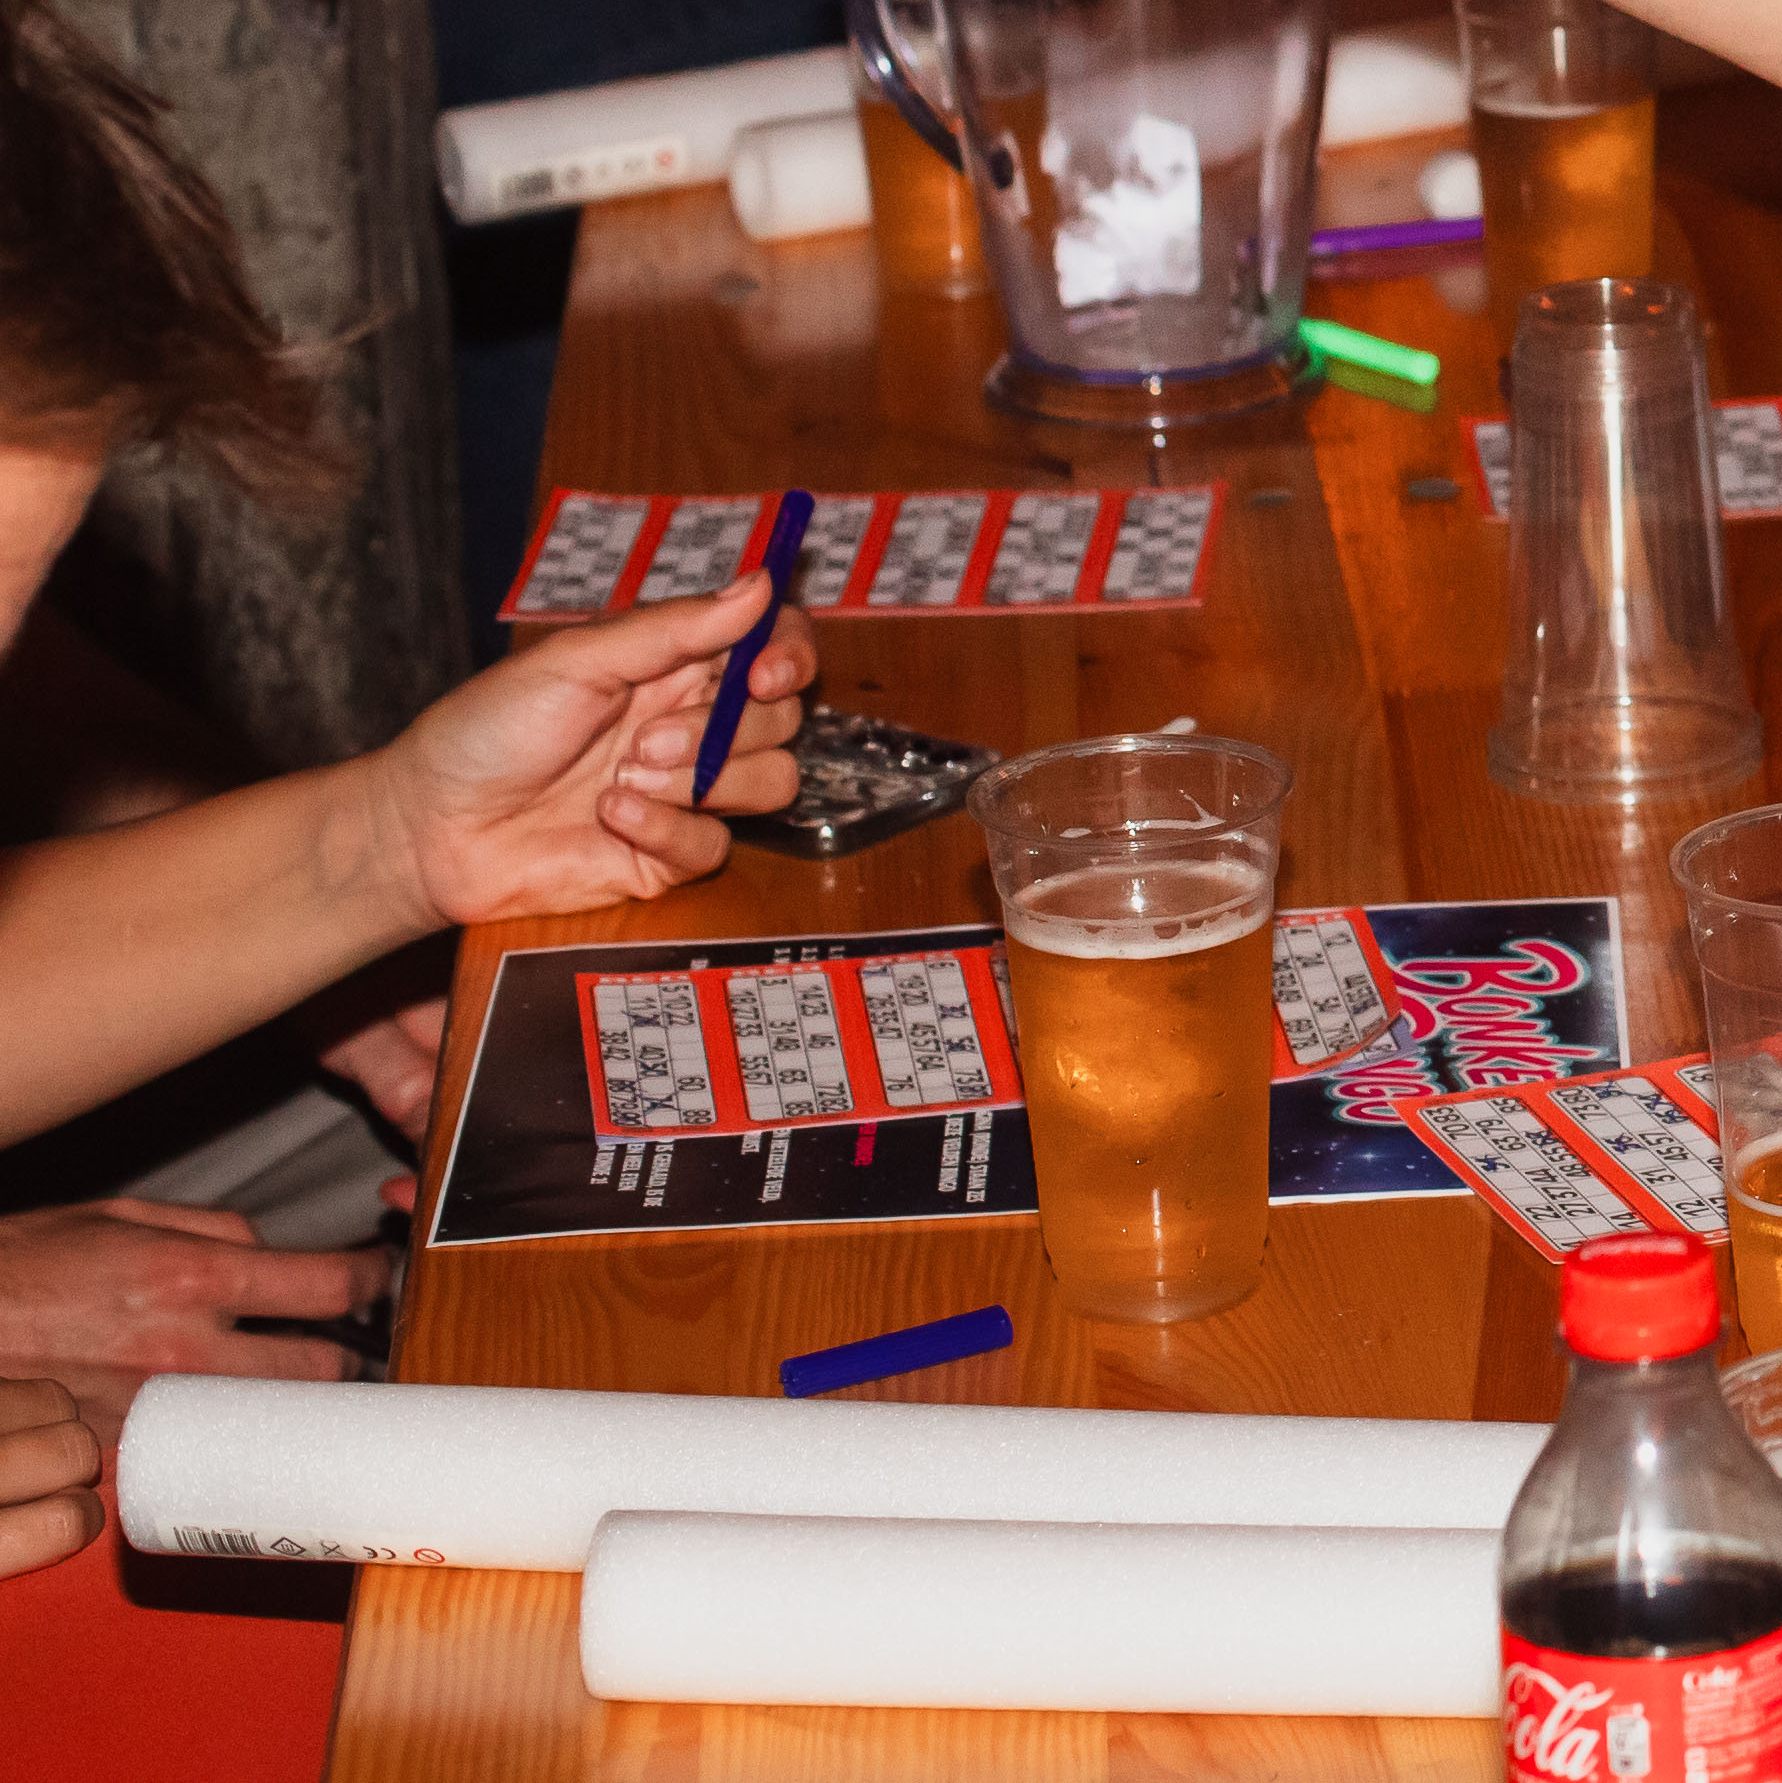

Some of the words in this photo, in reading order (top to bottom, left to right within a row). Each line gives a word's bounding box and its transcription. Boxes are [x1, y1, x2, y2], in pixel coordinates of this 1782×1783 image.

[662, 985, 690, 993] 5
[760, 978, 788, 987] 3
[626, 996, 657, 1011] 11
[663, 995, 692, 1010] 10
[667, 1012, 696, 1026] 22
[1388, 938, 1608, 1090] BONKE
[769, 1020, 799, 1035] 31
[874, 1026, 904, 1039] 47
[600, 1030, 628, 1044] 38
[602, 1046, 632, 1061] 42
[638, 1046, 667, 1061] 40
[910, 1038, 942, 1054] 57
[886, 1074, 916, 1092] 76
[956, 1067, 984, 1084] 73
[677, 1077, 707, 1091] 60
[817, 1082, 847, 1097] 72
[610, 1093, 638, 1110] 79
[1556, 1088, 1590, 1103] 80
[1492, 1098, 1525, 1113] 85
[1574, 1104, 1608, 1120] 73
[682, 1109, 712, 1124] 89
[1424, 1107, 1462, 1124] 83
[1442, 1124, 1478, 1140] 70
[1475, 1118, 1511, 1134] 79
[1491, 1136, 1526, 1151] 63
[1638, 1132, 1674, 1146] 57
[1543, 1146, 1577, 1162] 55
[1654, 1146, 1690, 1161] 45
[1524, 1168, 1558, 1183] 44
[1562, 1163, 1592, 1178] 48
[1638, 1168, 1675, 1184] 31
[1542, 1185, 1578, 1200] 37
[1525, 1205, 1561, 1221] 22
[1556, 1200, 1596, 1216] 27
[1675, 1199, 1710, 1216] 12
[1609, 1212, 1644, 1227] 14
